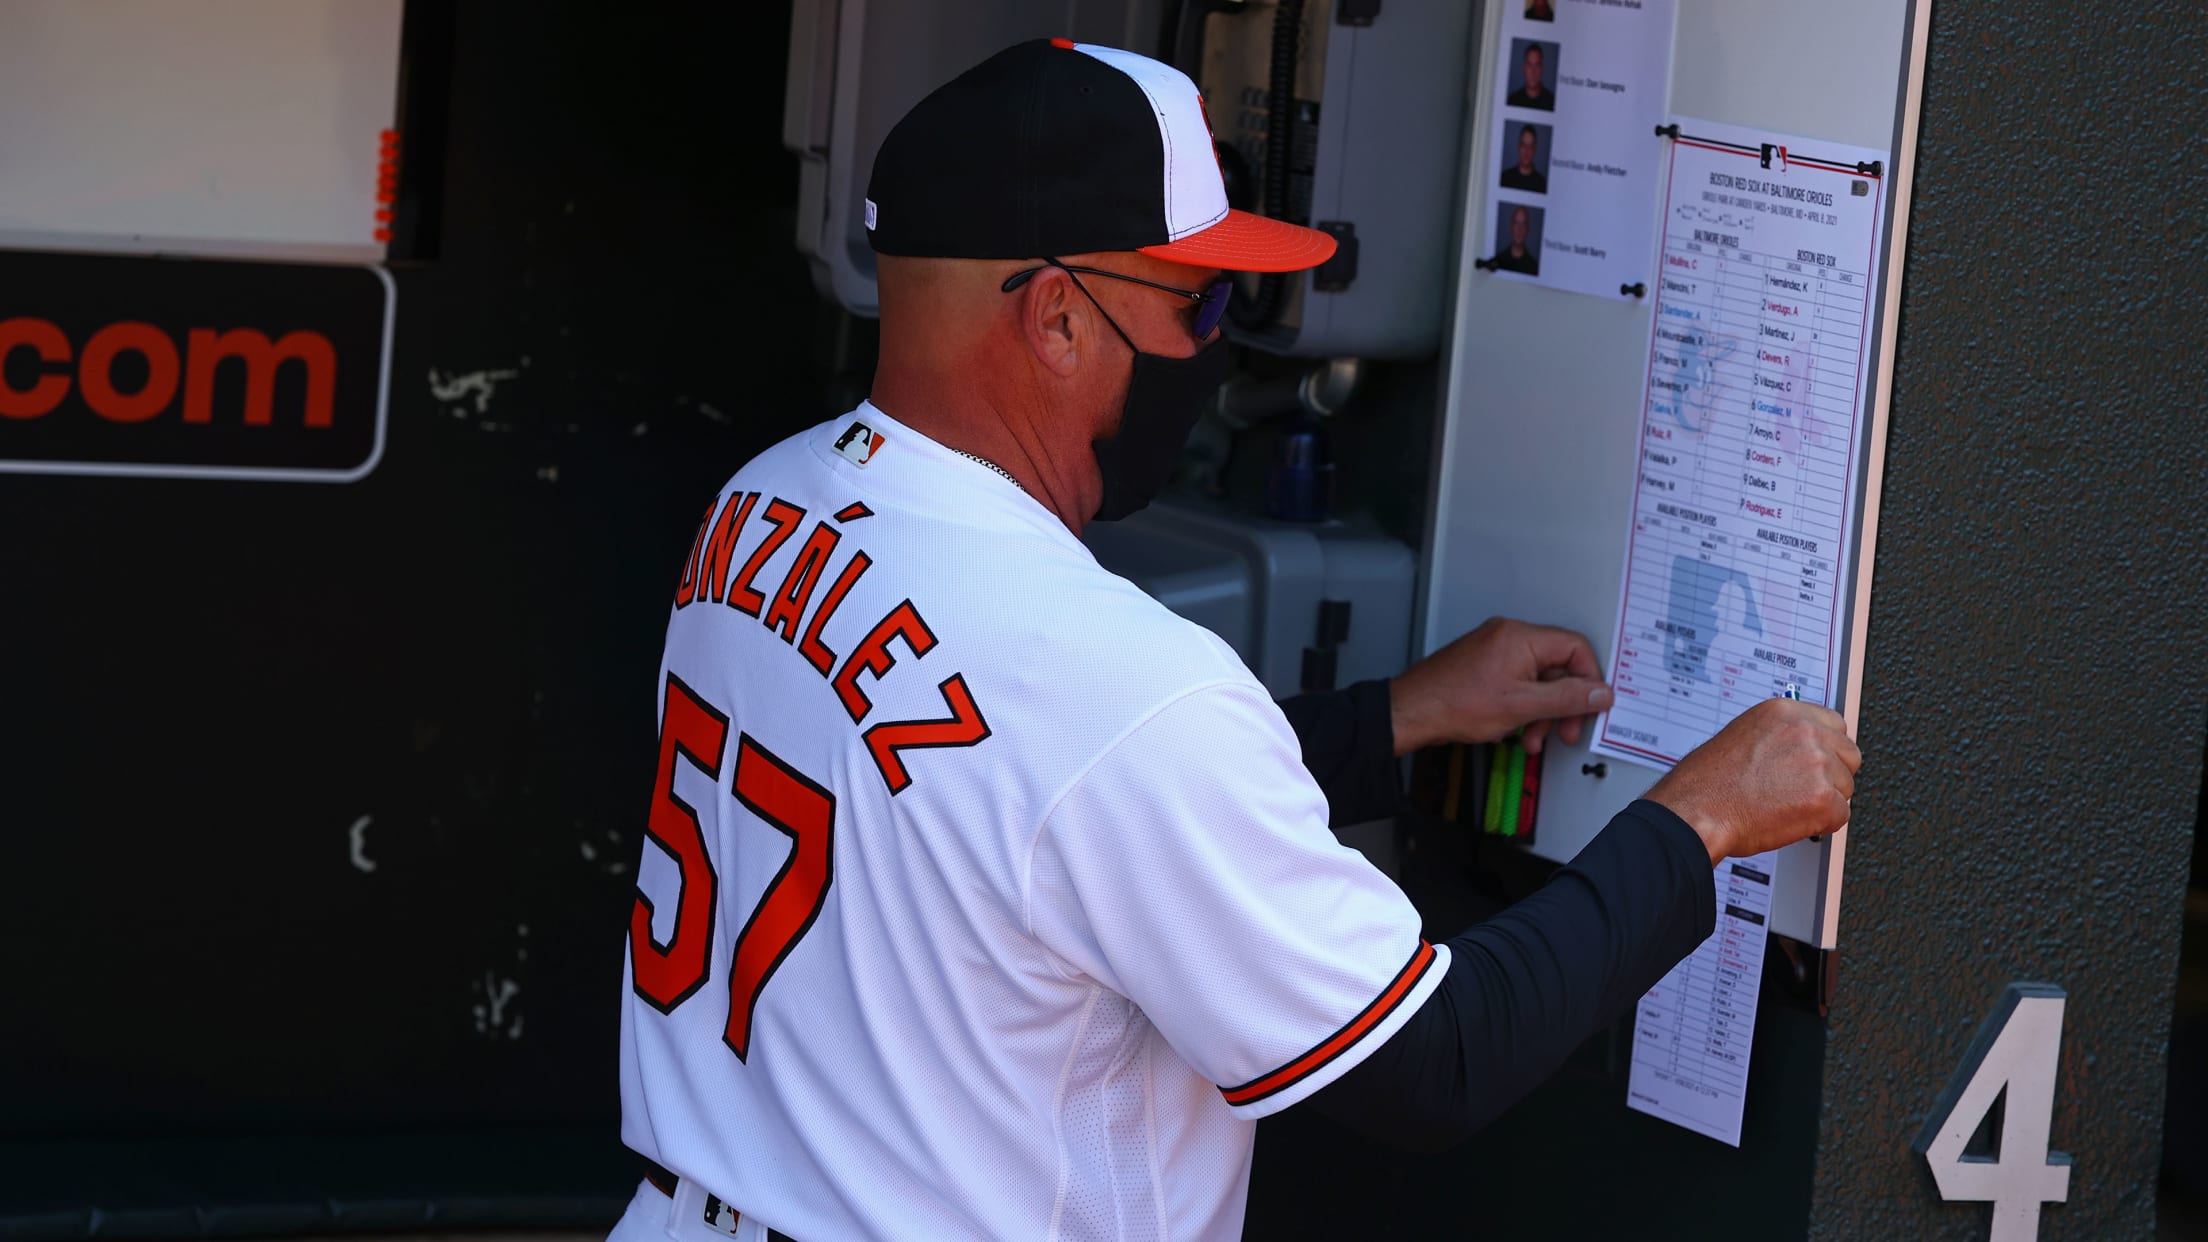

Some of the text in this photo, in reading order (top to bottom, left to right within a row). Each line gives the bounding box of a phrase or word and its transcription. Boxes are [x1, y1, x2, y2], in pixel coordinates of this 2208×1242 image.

[1587, 162, 1602, 175] Andy
[1710, 172, 1833, 206] BOSTON RED SOX AT BALTIMORE ORIOLES
[1693, 229, 1739, 248] BALTIMORE ORIOLES
[1797, 249, 1836, 267] BOSTON RED SOX
[1765, 274, 1768, 285] 1
[1803, 282, 1808, 293] K
[1762, 298, 1798, 317] 2 Verdugo, A
[1759, 323, 1763, 335] 3
[1790, 331, 1795, 342] J
[1757, 349, 1790, 366] 4 Devers, R
[0, 316, 338, 427] com
[1754, 373, 1758, 386] 5
[1786, 382, 1791, 392] C
[1752, 399, 1756, 410] 6
[1785, 407, 1791, 417] M
[1749, 423, 1753, 434] 7
[1775, 430, 1780, 441] C
[1746, 449, 1750, 460] 8
[1777, 456, 1781, 466] F
[1743, 473, 1776, 491] 9 Dalbec, B
[1777, 508, 1782, 519] E
[1757, 528, 1817, 553] AVAILABLE POSITION PLAYERS
[1754, 647, 1796, 669] AVAILABLE PITCHERS
[629, 669, 837, 1066] 57
[1920, 984, 2073, 1242] 4
